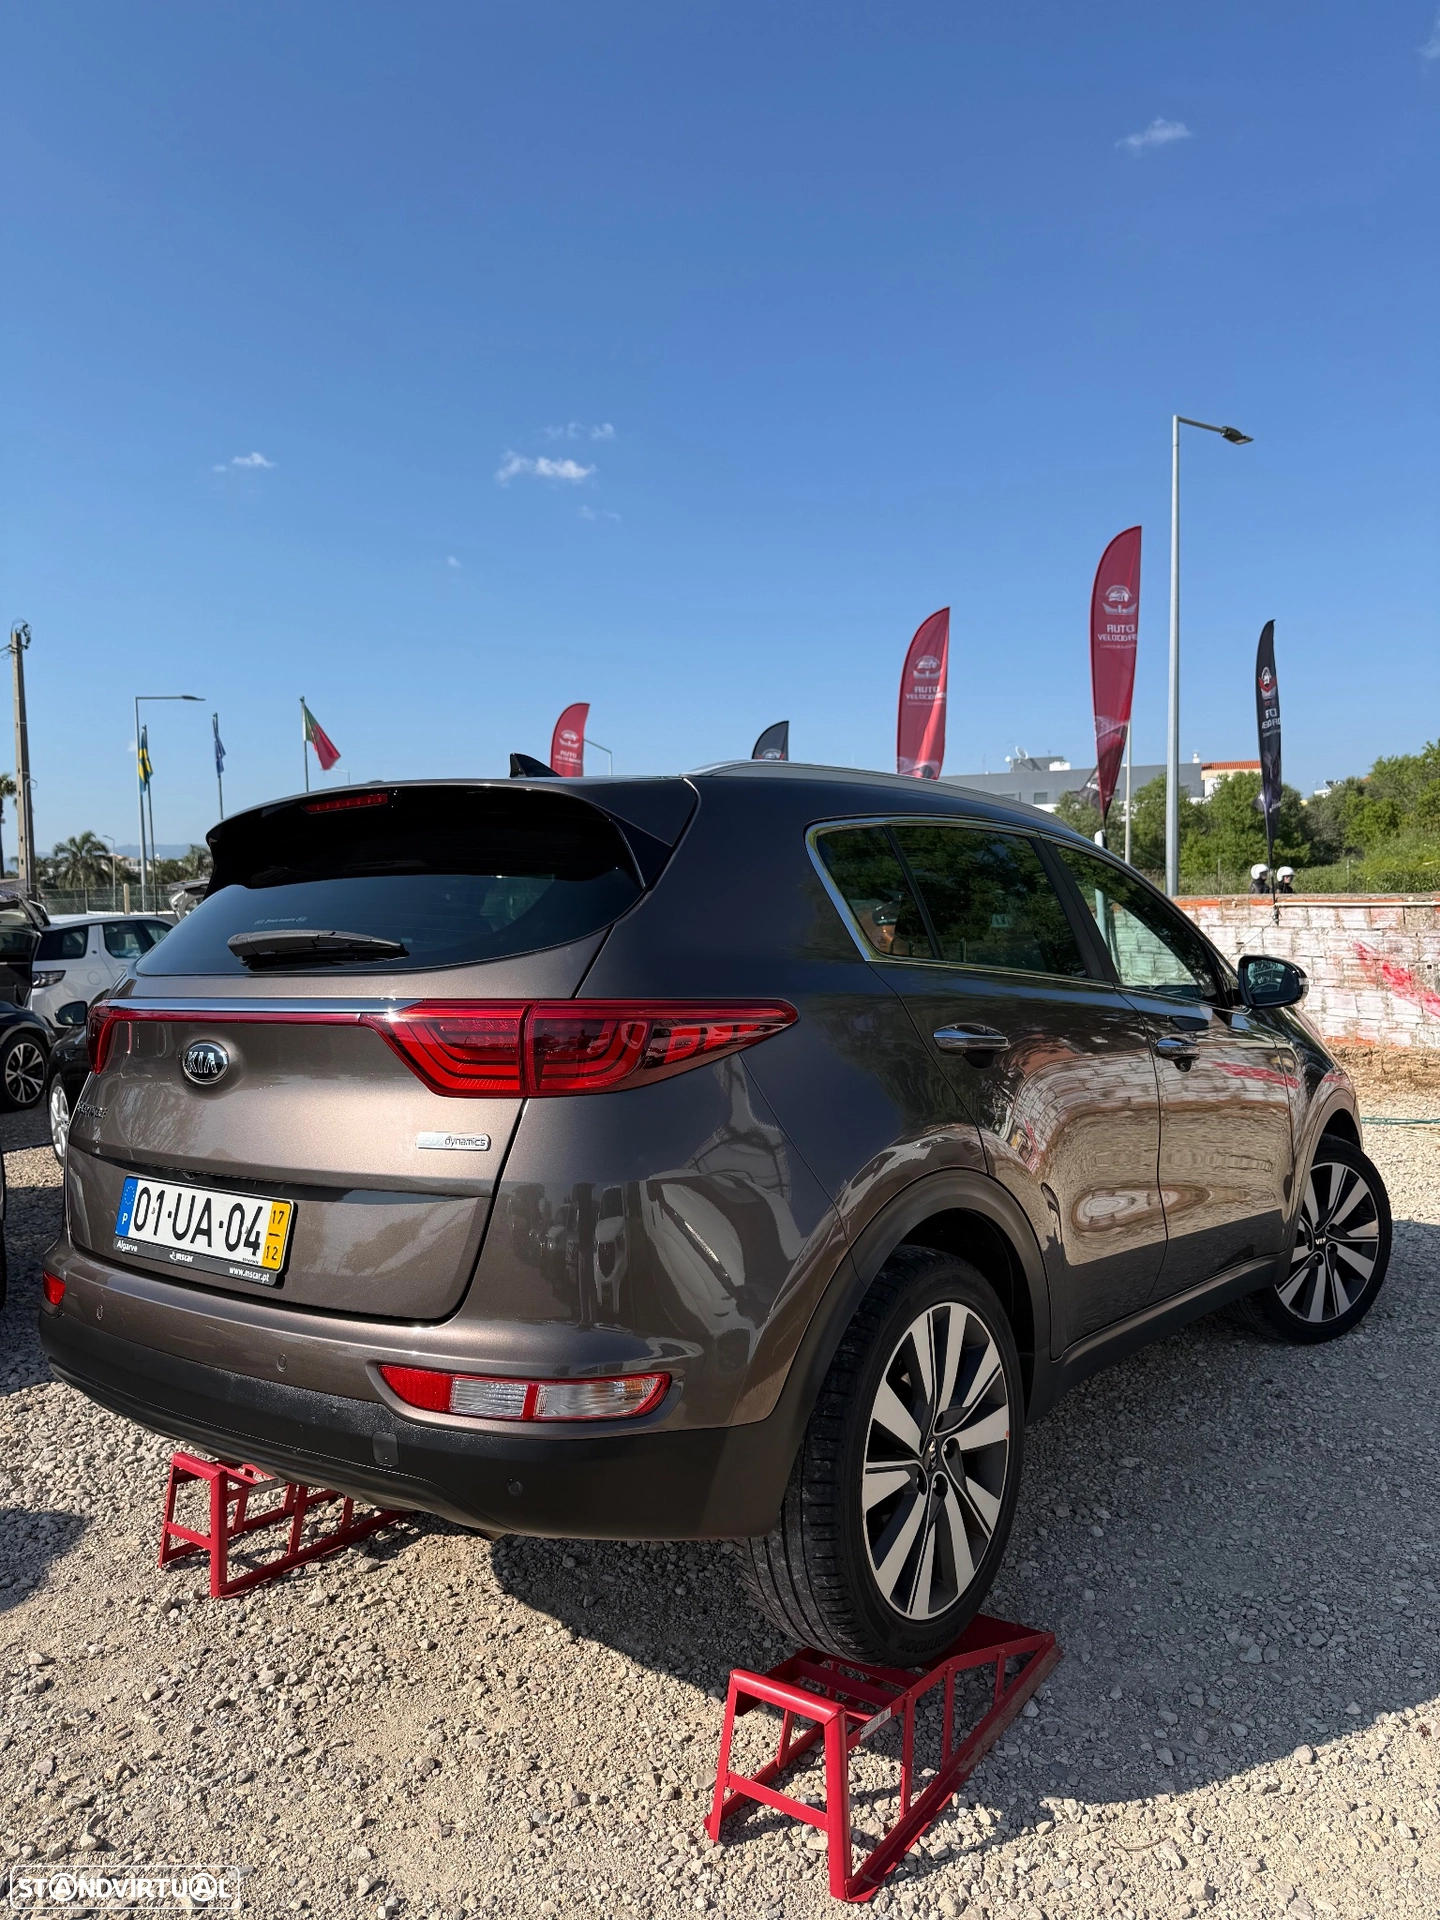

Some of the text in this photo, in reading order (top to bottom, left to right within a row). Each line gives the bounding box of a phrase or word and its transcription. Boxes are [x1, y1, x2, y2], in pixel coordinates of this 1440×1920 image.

[1106, 624, 1135, 633] AUTO
[914, 685, 940, 693] AUTO
[187, 1051, 218, 1074] KIA
[444, 1135, 486, 1147] dynamics
[121, 1213, 129, 1225] P
[271, 1210, 285, 1225] 17
[116, 1240, 138, 1252] Algarve
[265, 1245, 279, 1261] 12
[228, 1266, 270, 1284] www.mscar.pt
